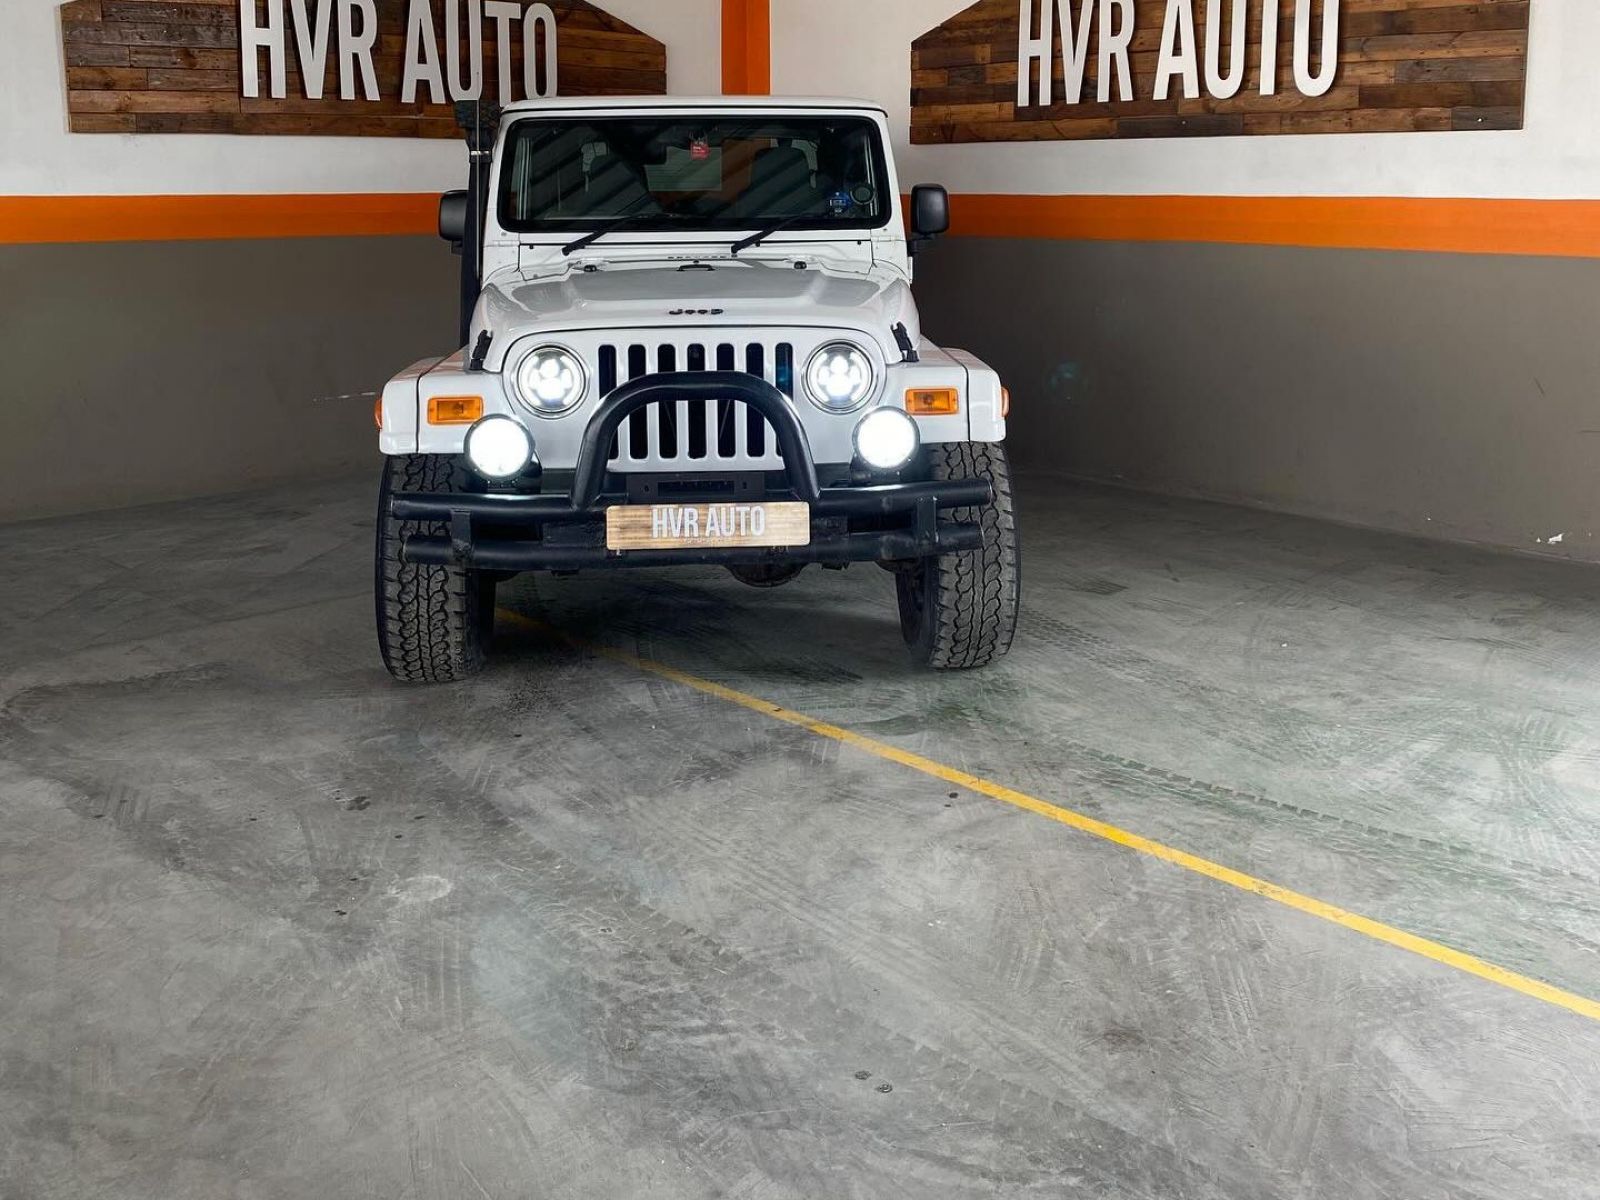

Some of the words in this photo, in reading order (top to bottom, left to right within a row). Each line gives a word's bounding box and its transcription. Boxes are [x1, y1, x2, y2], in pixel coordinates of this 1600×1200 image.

[240, 0, 381, 100] HVR
[401, 0, 558, 106] AUTO
[1017, 0, 1134, 107] HVR
[1152, 0, 1340, 101] AUTO
[651, 507, 699, 538] HVR
[705, 505, 766, 537] AUTO
